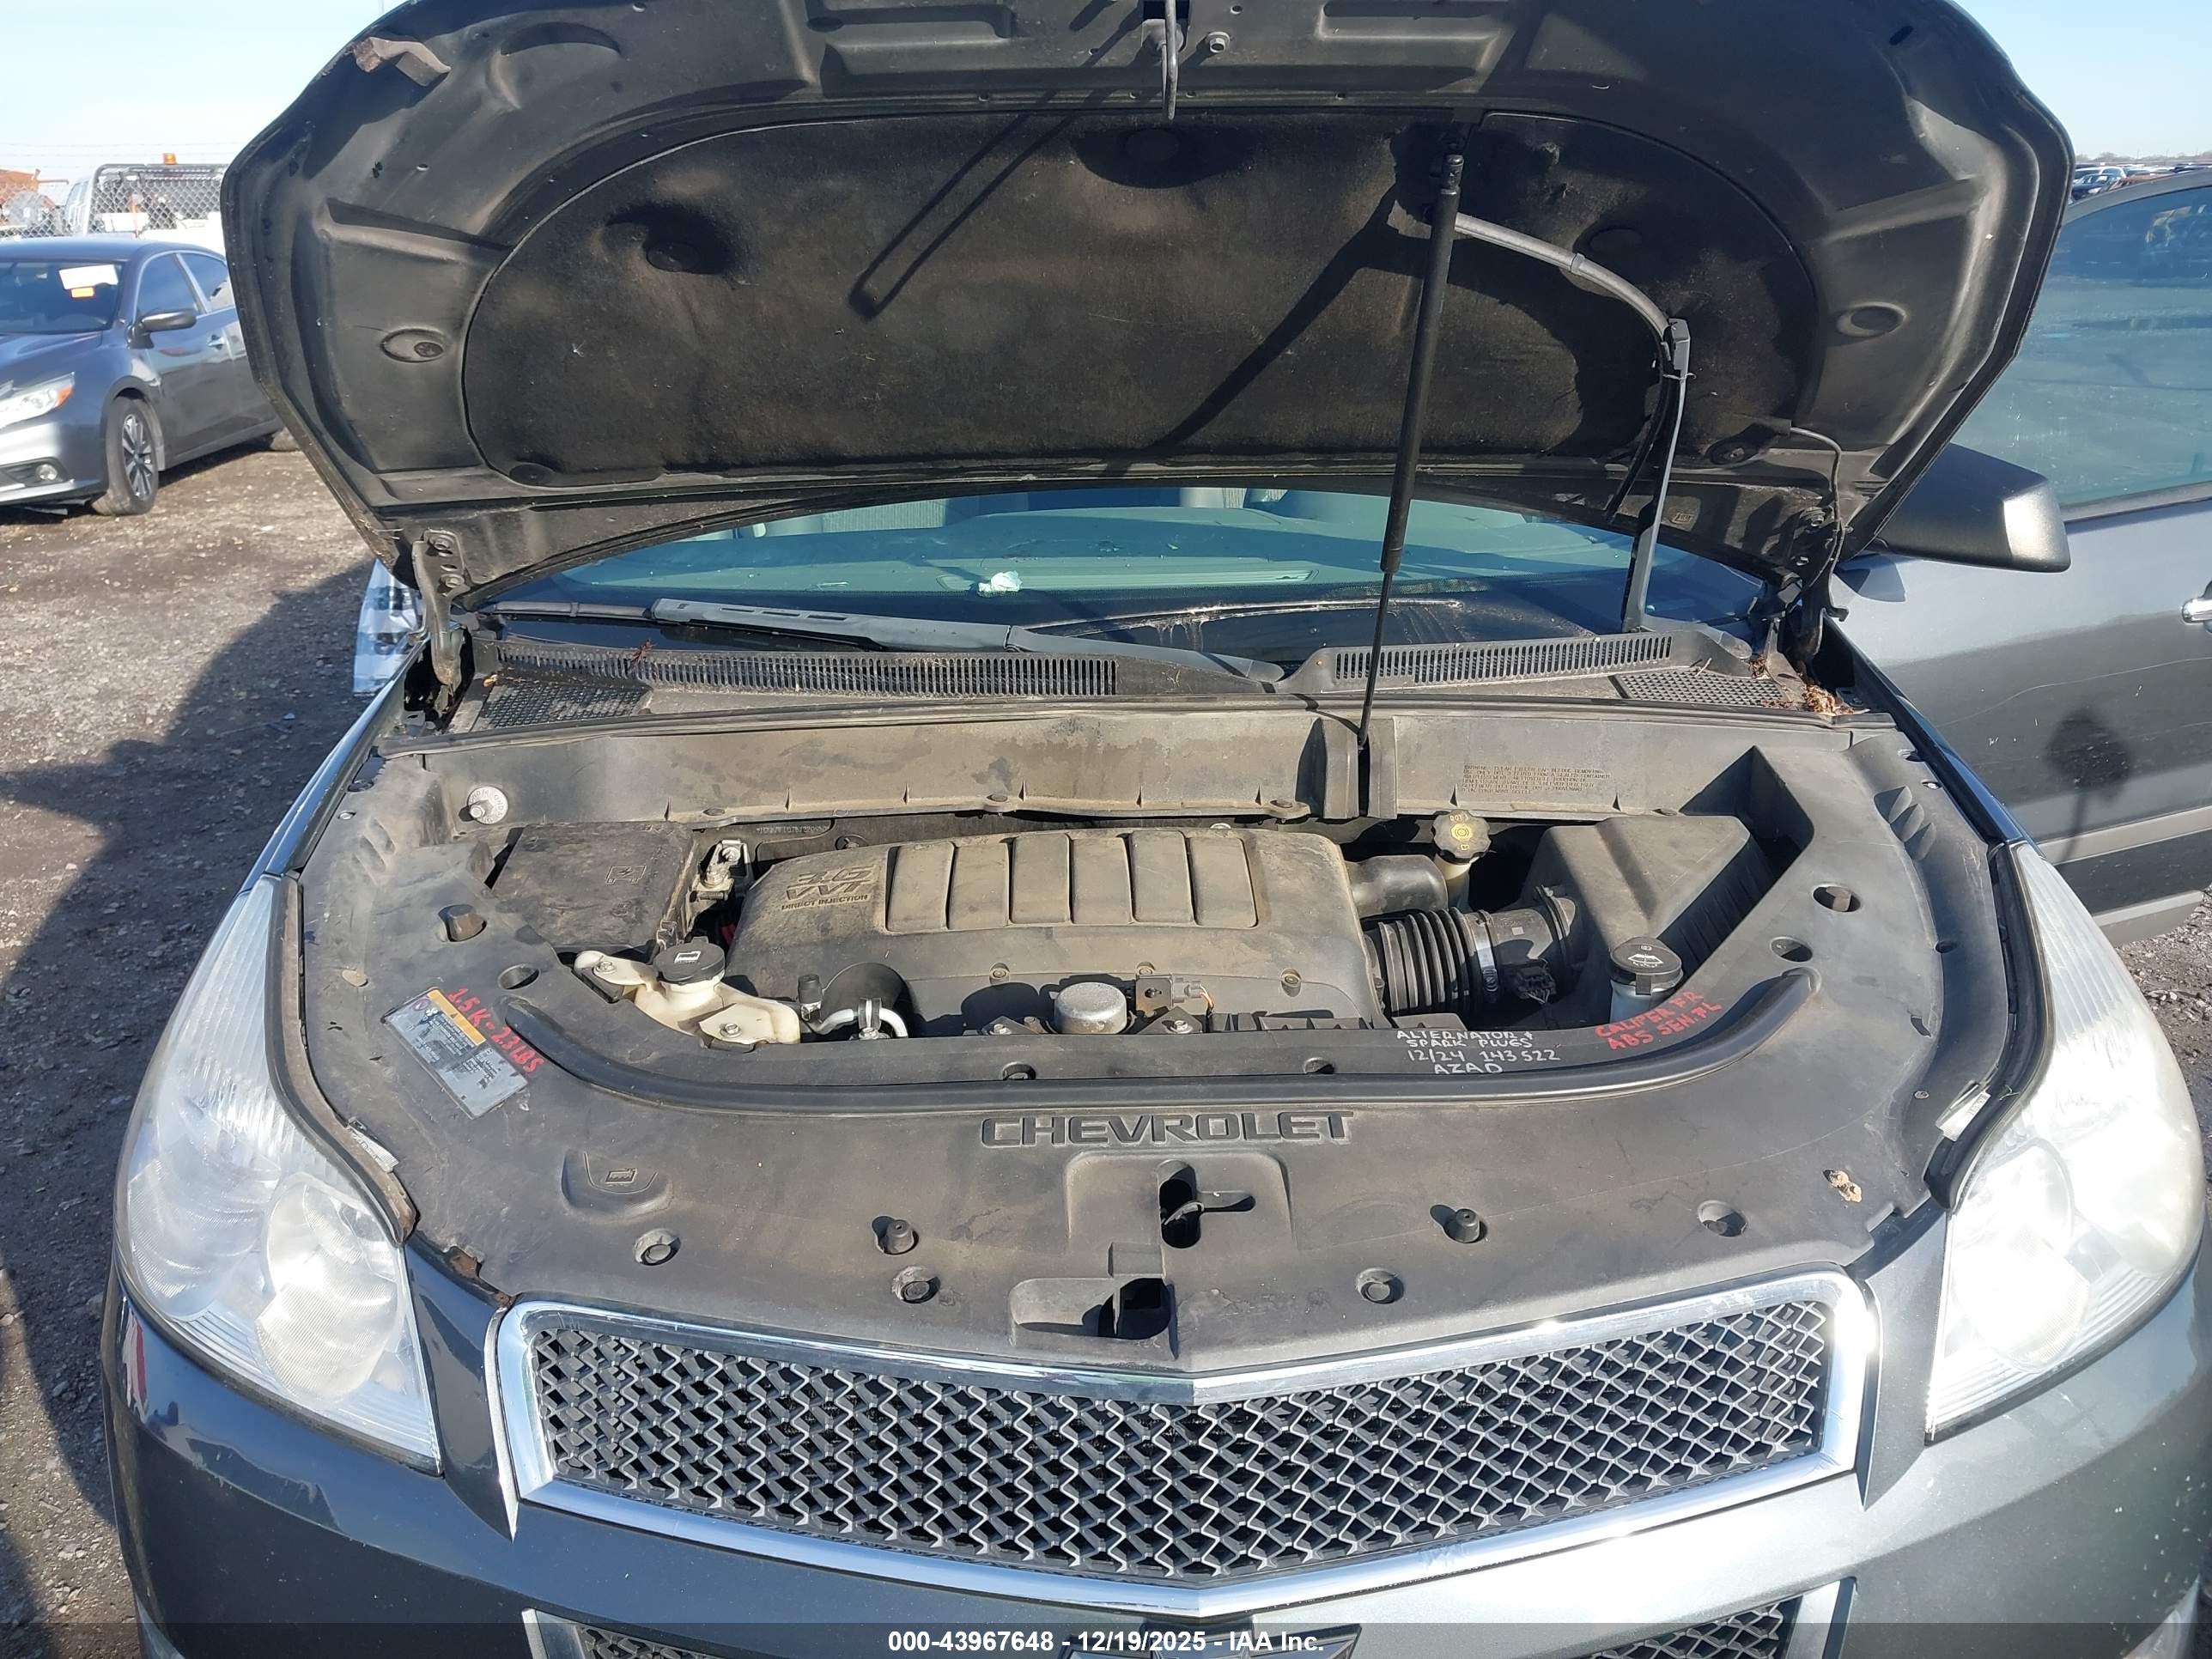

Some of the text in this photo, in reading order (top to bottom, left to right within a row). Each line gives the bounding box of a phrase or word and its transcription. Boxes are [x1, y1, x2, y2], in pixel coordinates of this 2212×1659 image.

[786, 880, 874, 901] VVT
[818, 894, 869, 906] INJECTION
[1594, 1007, 1674, 1037] CALIPER
[1397, 1030, 1518, 1040] ALTERNATOR
[1407, 1037, 1533, 1048] SPARK PLUGS
[1607, 1030, 1654, 1049] ABS
[1408, 1048, 1466, 1063] 12/24
[1434, 1062, 1504, 1074] AZAD
[981, 1111, 1354, 1148] CHEVROLET
